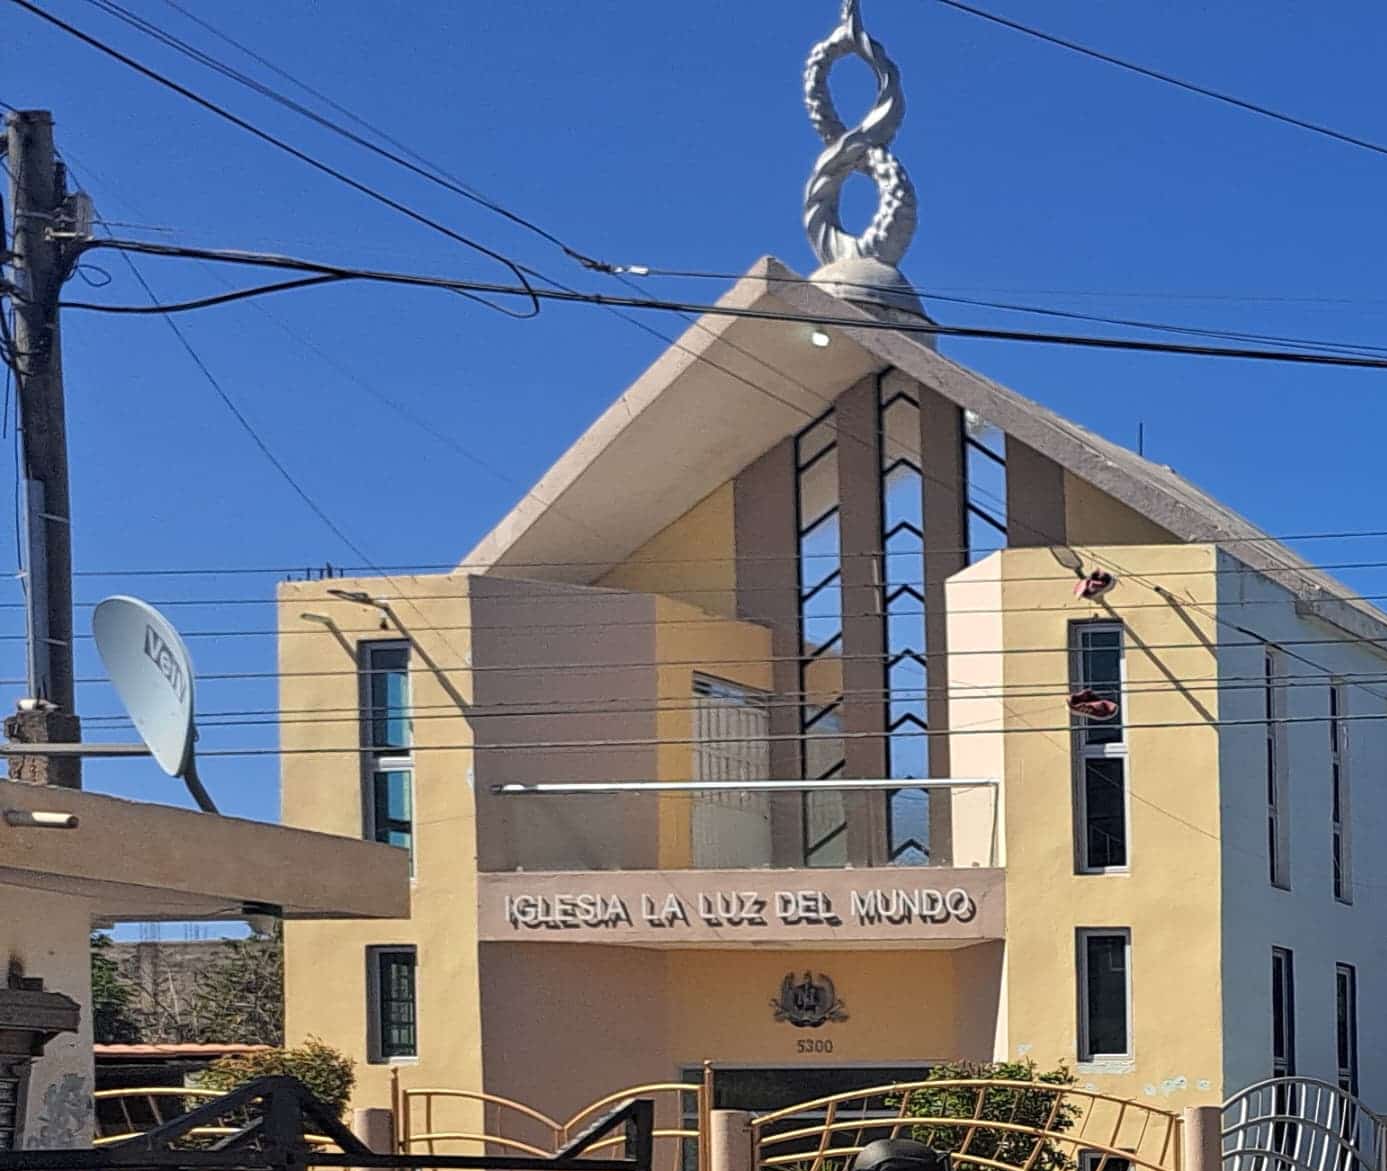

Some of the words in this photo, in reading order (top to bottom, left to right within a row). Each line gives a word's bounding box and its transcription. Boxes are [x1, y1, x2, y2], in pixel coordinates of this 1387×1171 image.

[505, 893, 627, 922] IGLESIA
[642, 893, 682, 920] LA
[699, 891, 763, 919] LUZ
[775, 890, 836, 919] DEL
[850, 887, 973, 917] MUNDO
[797, 1039, 834, 1054] 5300
